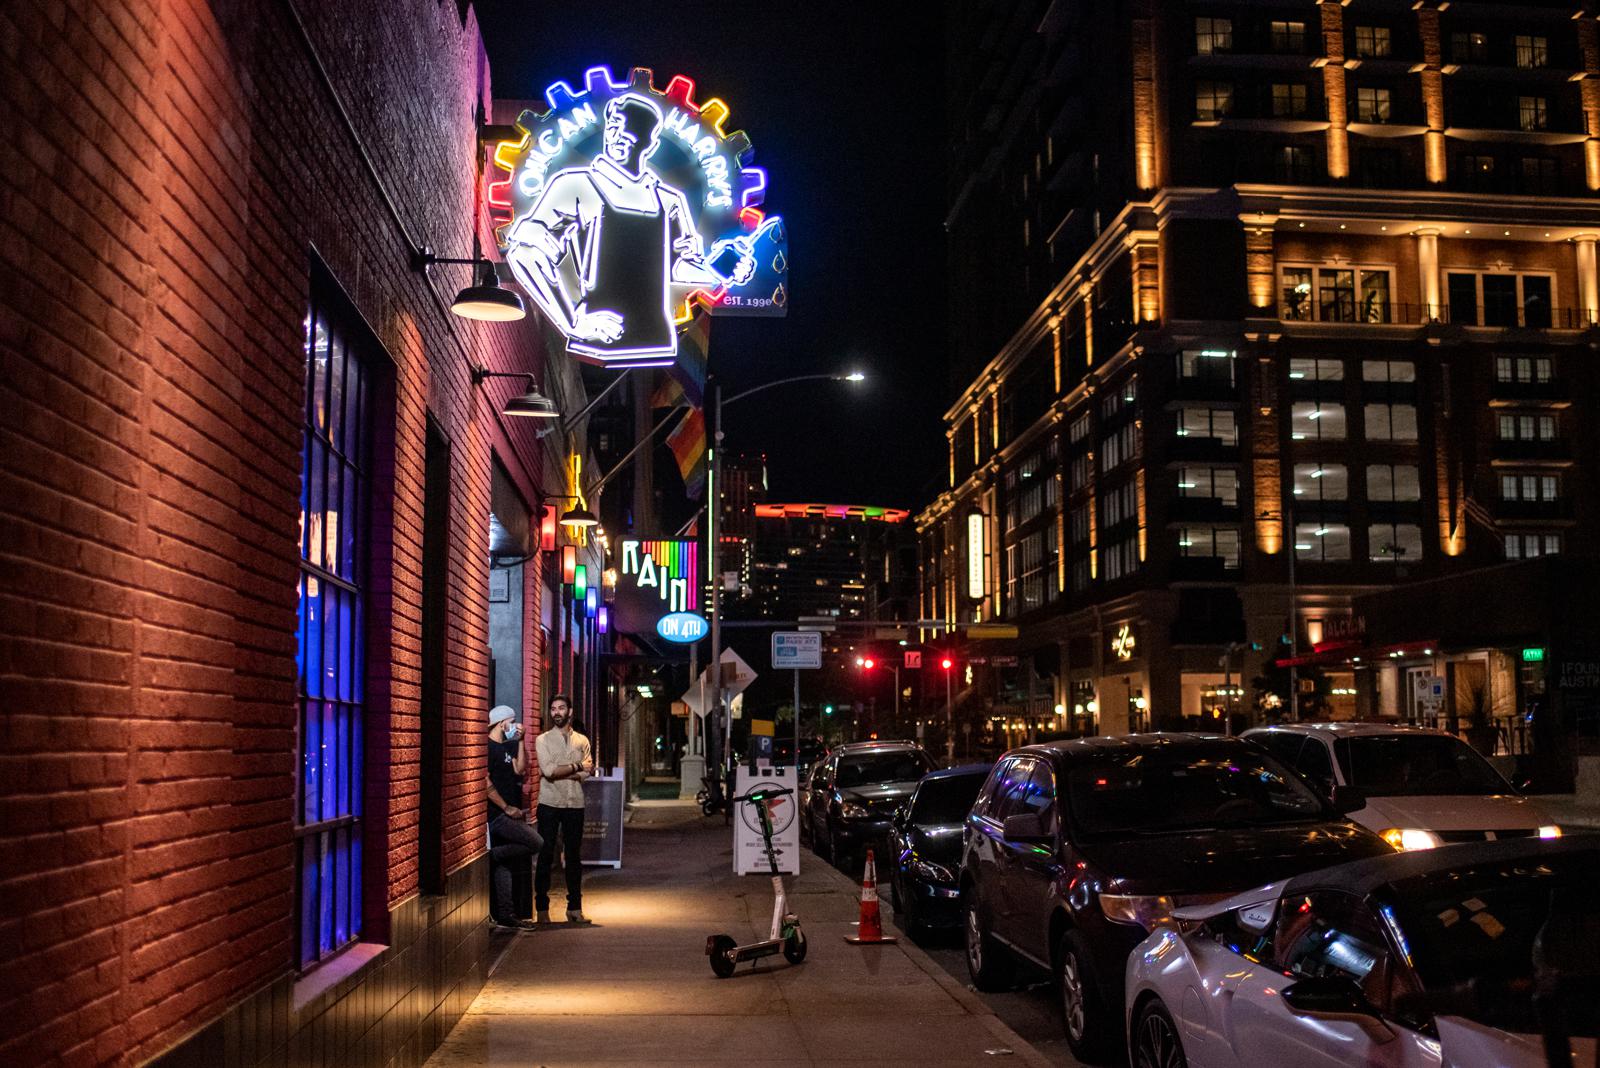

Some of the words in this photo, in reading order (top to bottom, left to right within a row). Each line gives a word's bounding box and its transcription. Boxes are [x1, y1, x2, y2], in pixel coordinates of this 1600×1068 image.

[518, 102, 597, 197] OILCAN
[746, 298, 772, 308] 1990
[663, 618, 678, 635] ON
[681, 620, 701, 638] 4TH
[761, 737, 770, 751] P
